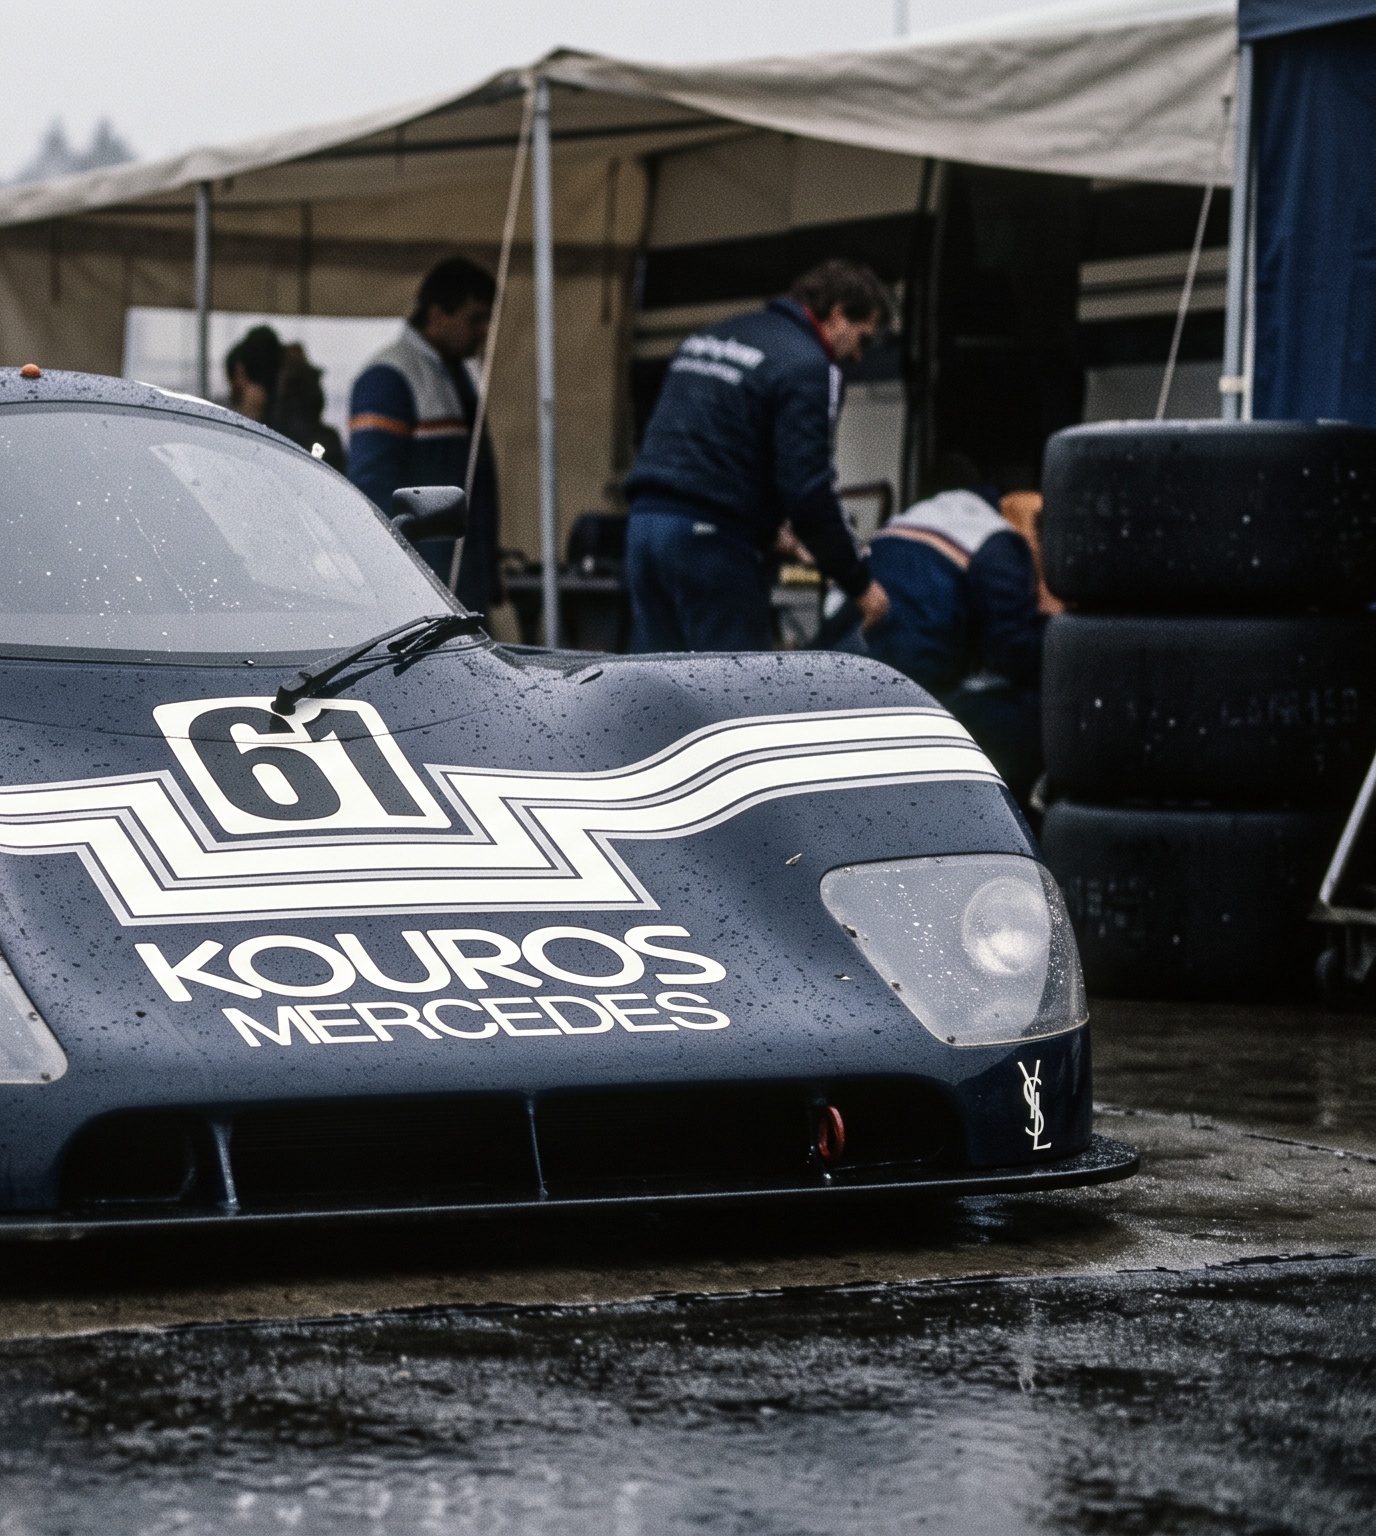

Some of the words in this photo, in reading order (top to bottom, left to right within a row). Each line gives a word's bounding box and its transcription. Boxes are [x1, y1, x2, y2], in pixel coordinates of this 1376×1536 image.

[188, 706, 427, 822] 61
[134, 924, 727, 1002] KOUROS
[222, 991, 730, 1048] MERCEDES
[1017, 1060, 1052, 1150] YSL
